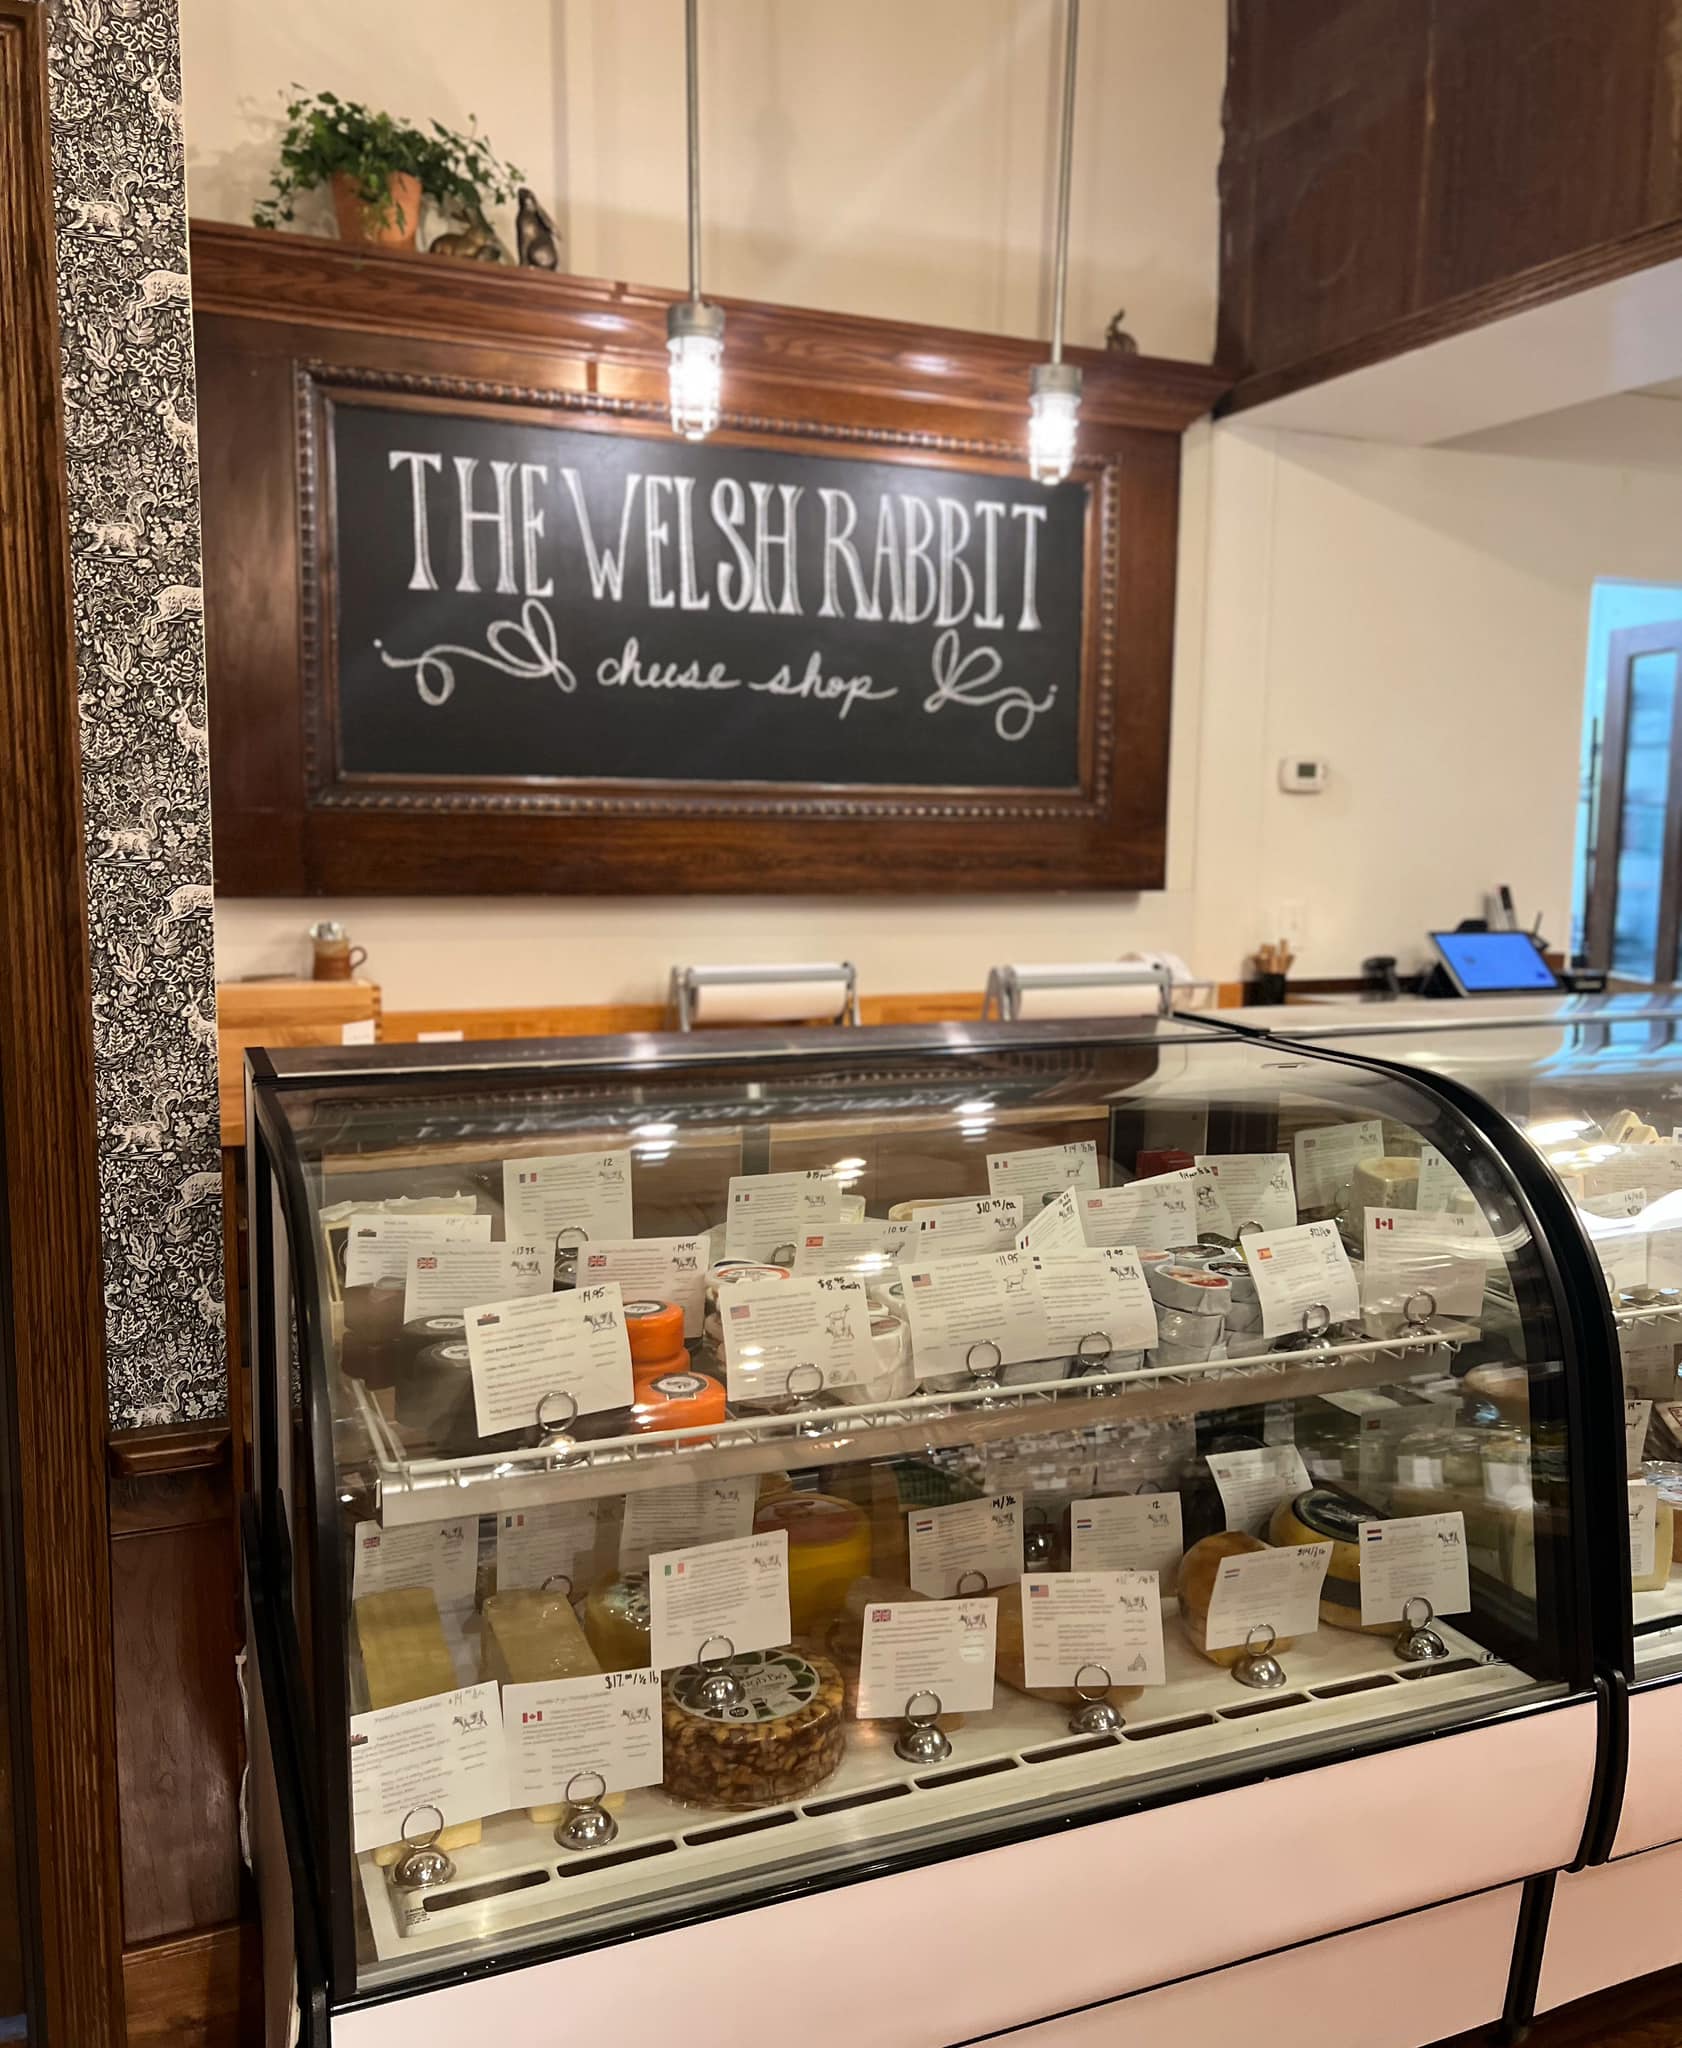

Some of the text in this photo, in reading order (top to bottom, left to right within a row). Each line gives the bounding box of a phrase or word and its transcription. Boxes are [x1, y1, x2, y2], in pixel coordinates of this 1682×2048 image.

[389, 450, 1048, 631] THE WELSH RABBIT
[597, 636, 898, 720] cheese shop
[840, 1281, 861, 1290] each
[649, 1670, 659, 1684] lb
